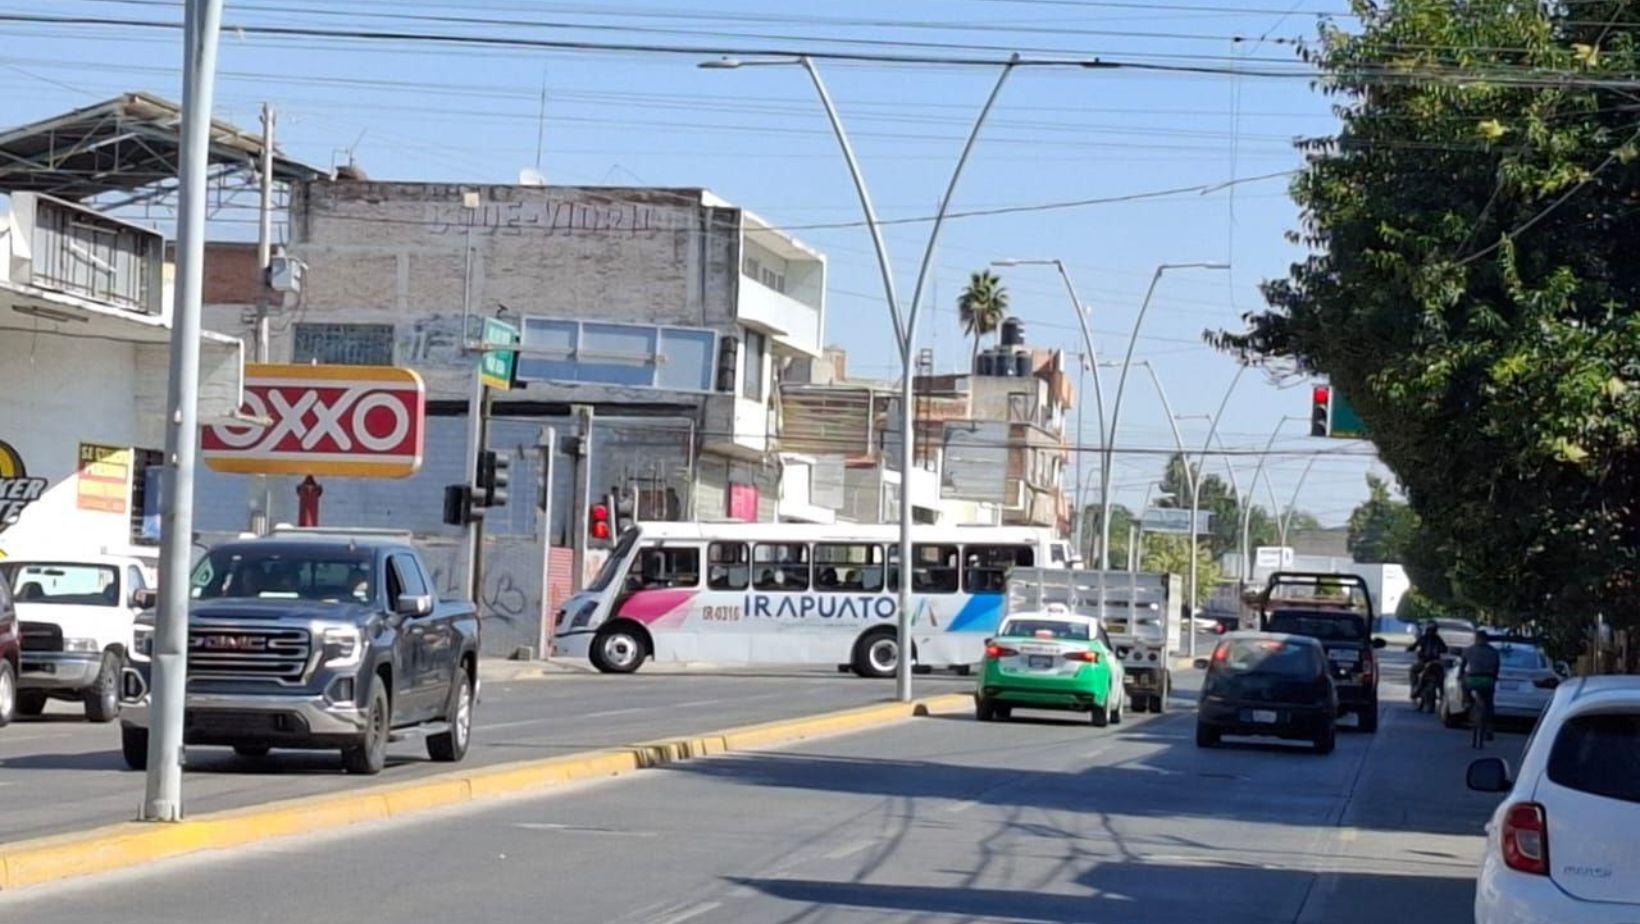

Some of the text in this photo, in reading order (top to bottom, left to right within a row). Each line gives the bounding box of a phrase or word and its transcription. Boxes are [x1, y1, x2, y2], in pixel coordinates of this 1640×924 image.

[211, 388, 410, 452] OXXO
[744, 595, 896, 618] IRAPUATO
[204, 635, 266, 650] GMC
